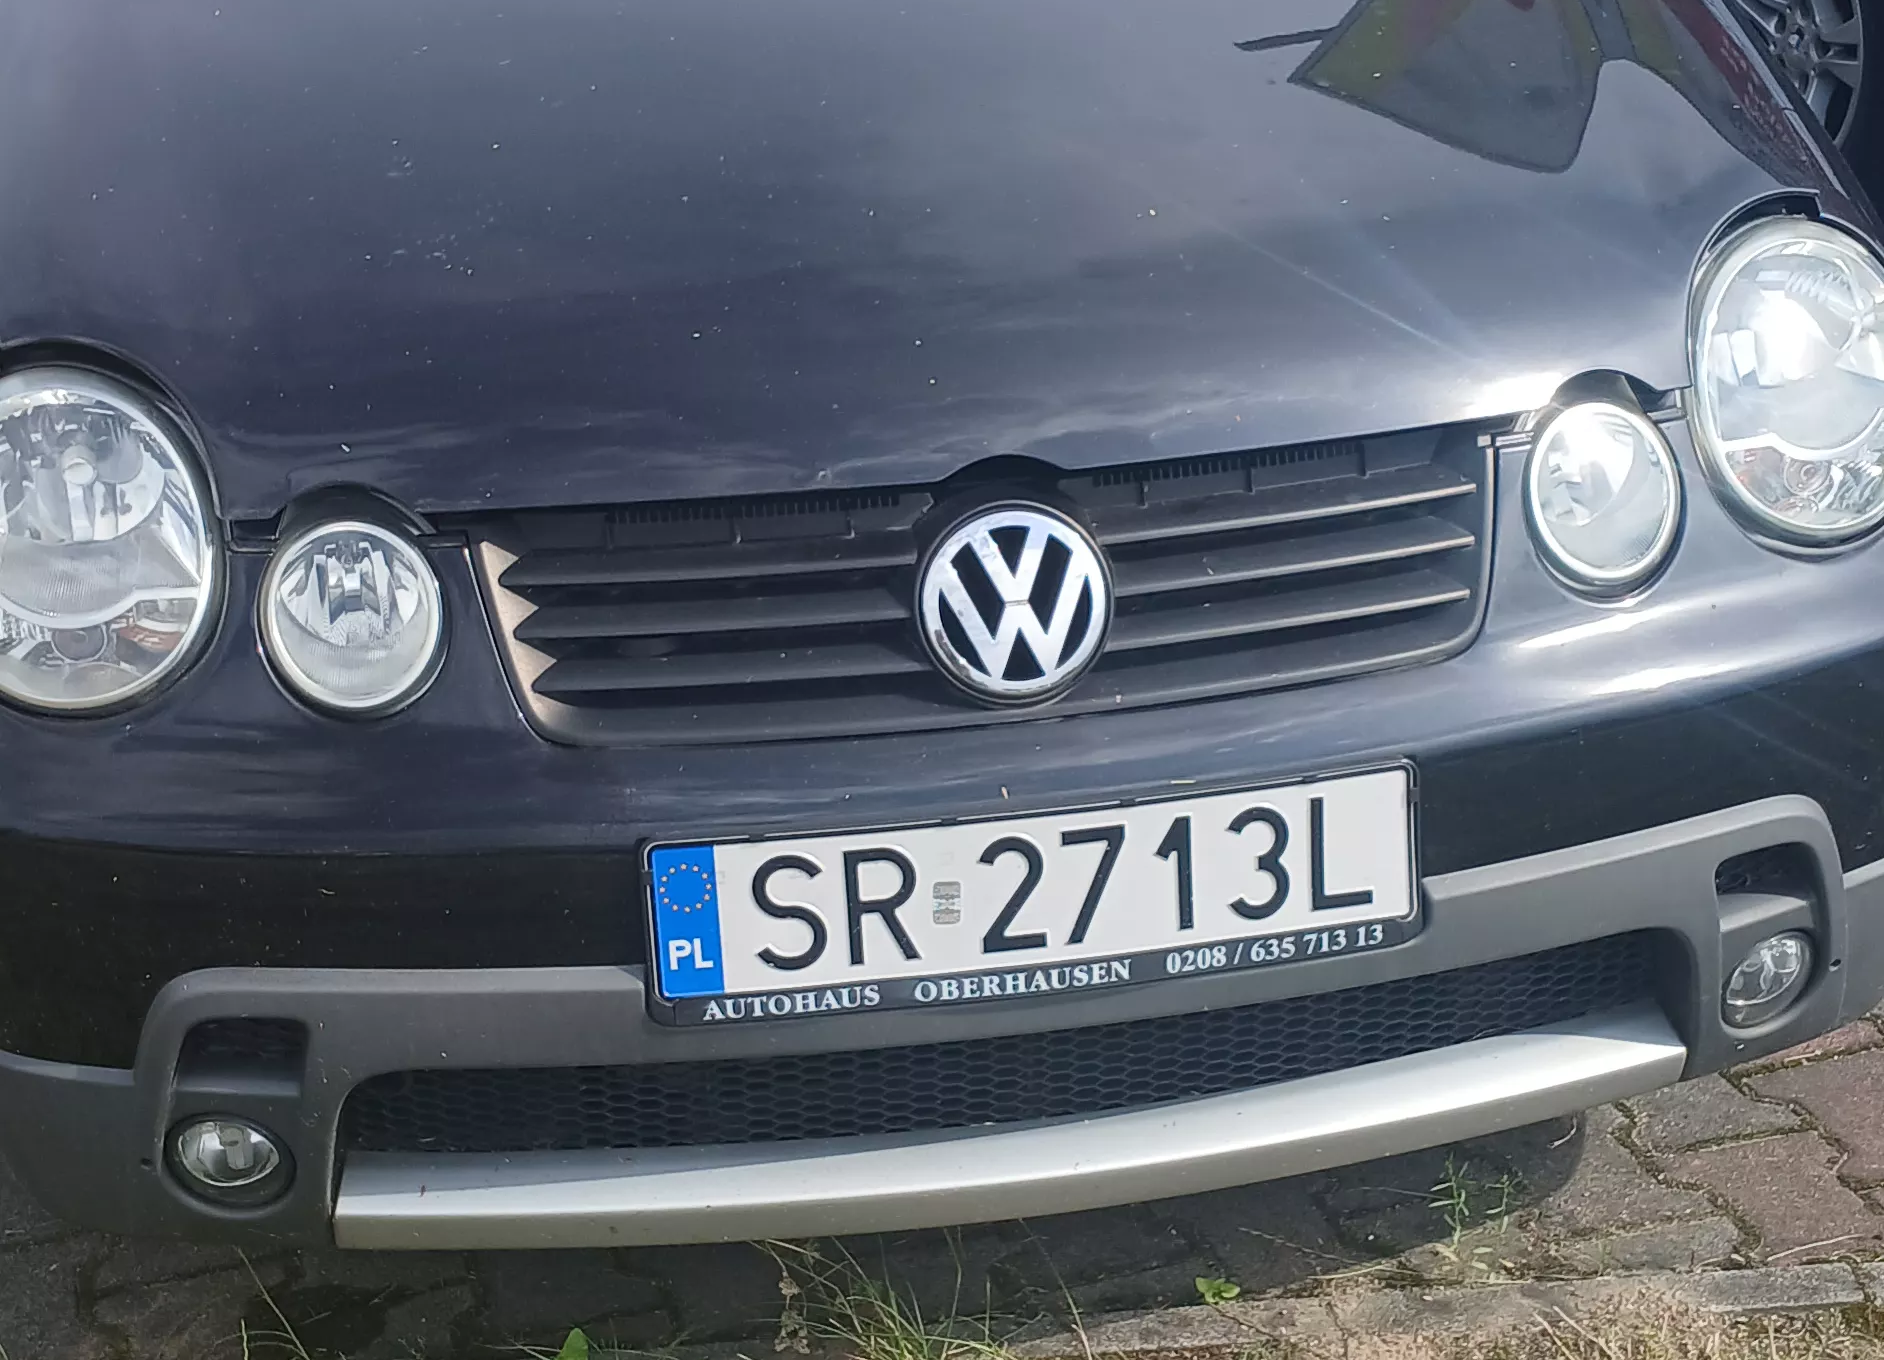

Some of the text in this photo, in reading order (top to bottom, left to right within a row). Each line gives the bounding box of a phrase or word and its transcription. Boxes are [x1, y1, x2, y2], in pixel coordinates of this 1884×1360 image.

[752, 796, 1374, 971] SR 2713L
[668, 937, 714, 971] PL
[702, 923, 1384, 1021] AUTOHAUS OBERHAUSEN 0208 / 635 713 13
